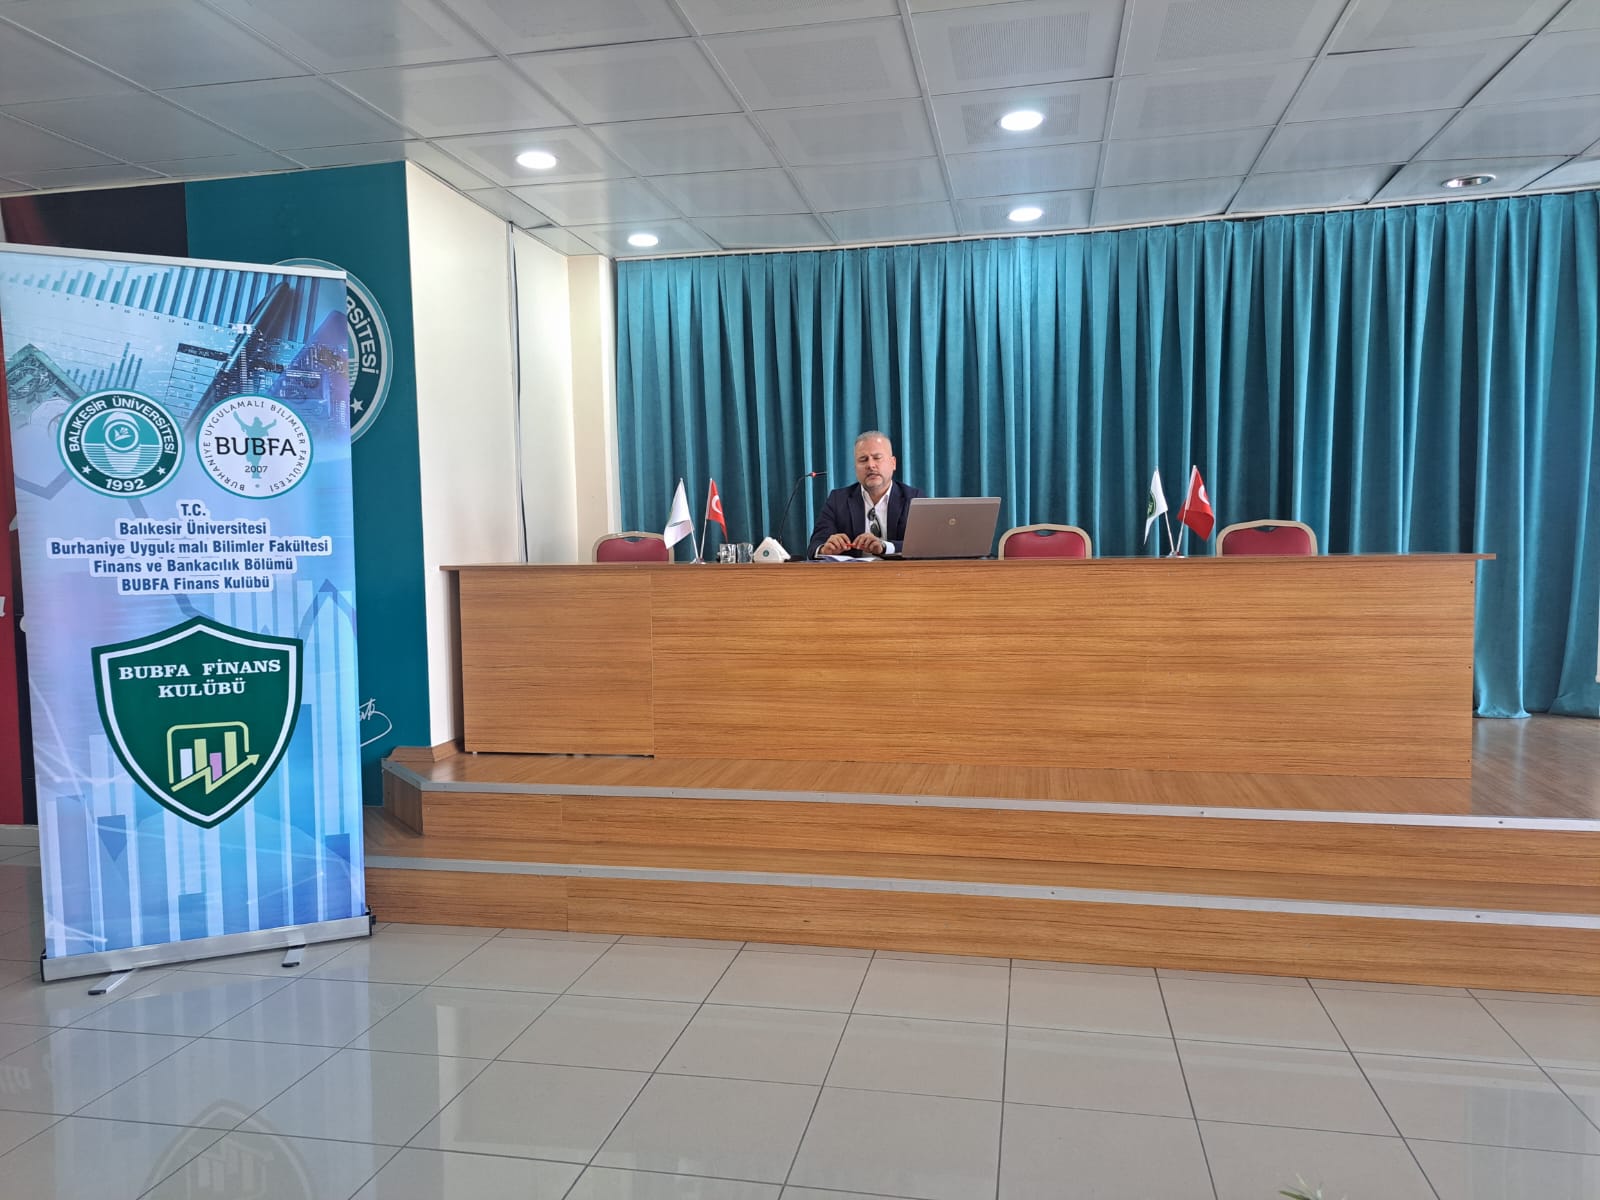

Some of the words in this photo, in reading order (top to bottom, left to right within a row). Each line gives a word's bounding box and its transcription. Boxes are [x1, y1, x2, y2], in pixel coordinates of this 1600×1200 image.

[68, 399, 107, 452] BALIKESİR
[112, 395, 177, 455] ÜNİVERSİTESİ
[204, 400, 264, 436] UYGULAMALI
[214, 436, 297, 456] BUBFA
[244, 465, 268, 473] 2007
[105, 478, 147, 491] 1992
[180, 503, 206, 516] T.C.
[119, 522, 181, 535] Balıkesir
[187, 519, 266, 535] Üniversitesi
[51, 541, 125, 557] Burhaniye
[213, 539, 264, 552] Bilimler
[269, 538, 328, 552] Fakültesi
[94, 559, 142, 573] Finans
[147, 563, 162, 571] ve
[167, 558, 240, 572] Bankacılık
[244, 557, 293, 570] Bölümü
[121, 578, 169, 591] BUBFA
[174, 577, 219, 590] Finans
[224, 575, 270, 588] Kulübü
[118, 664, 191, 680] BUBFA
[202, 658, 281, 675] FİNANS
[158, 678, 246, 698] KULÜBÜ
